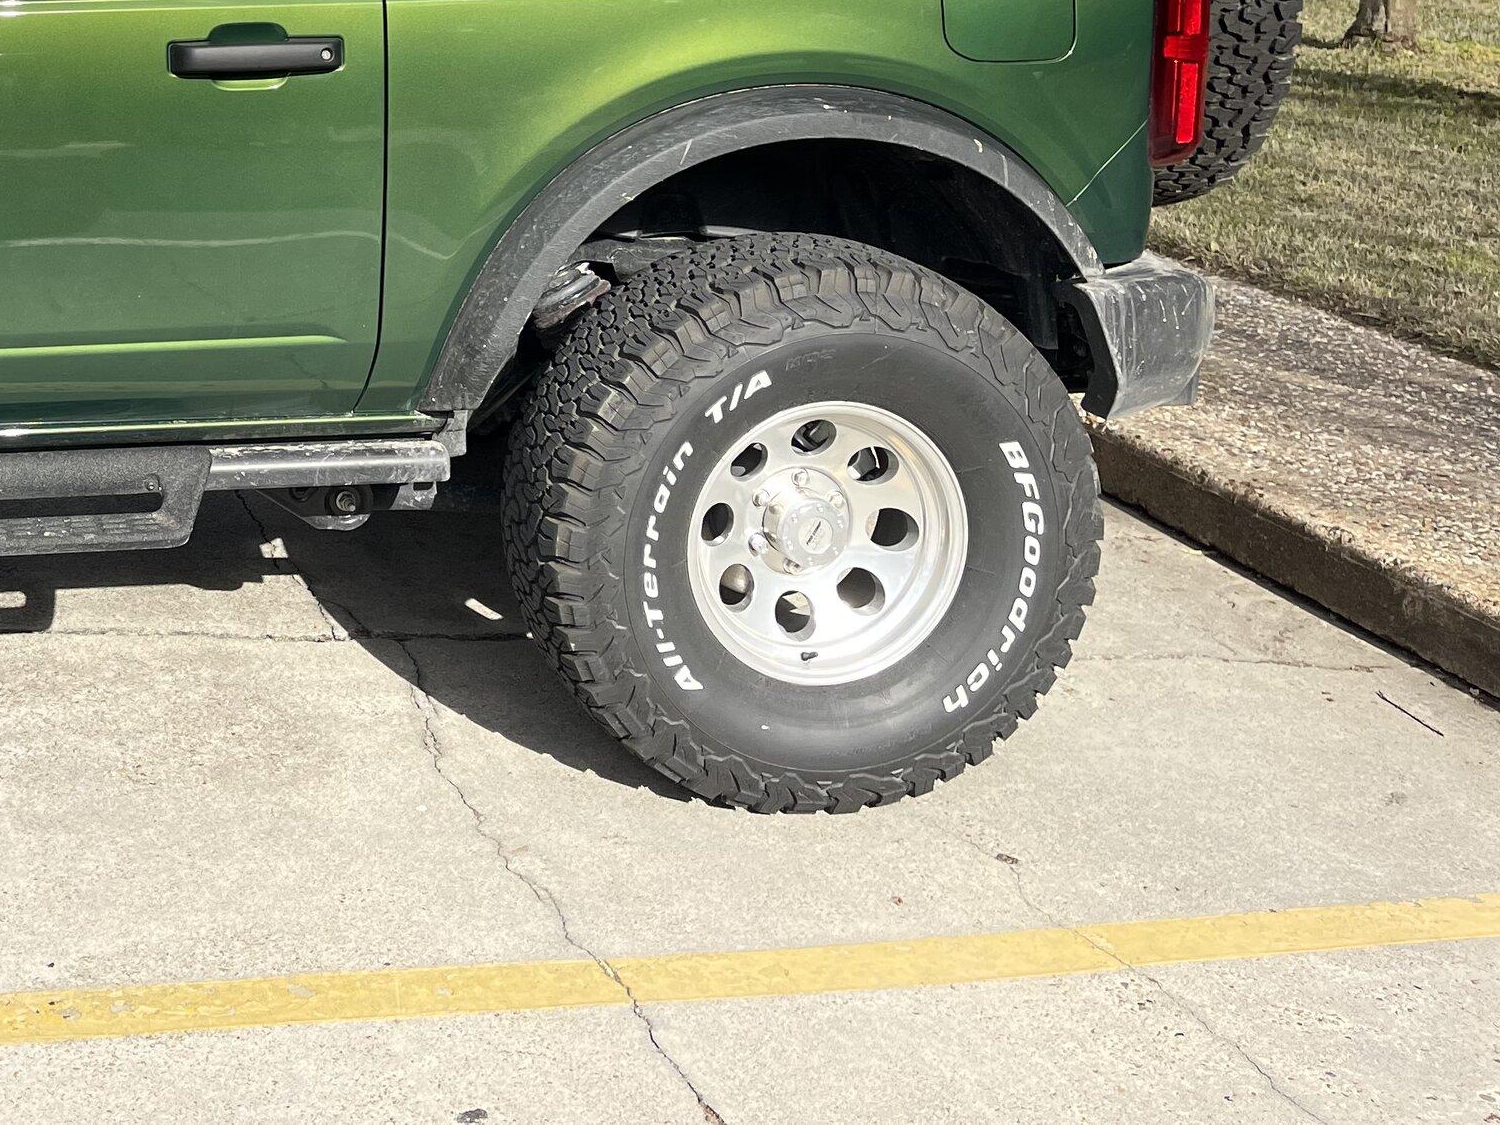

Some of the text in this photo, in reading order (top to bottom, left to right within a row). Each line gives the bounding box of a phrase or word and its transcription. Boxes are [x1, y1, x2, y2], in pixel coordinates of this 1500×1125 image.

[643, 441, 704, 690] All-Terrain
[704, 369, 772, 424] T/A
[942, 441, 1045, 713] BFGoodrich
